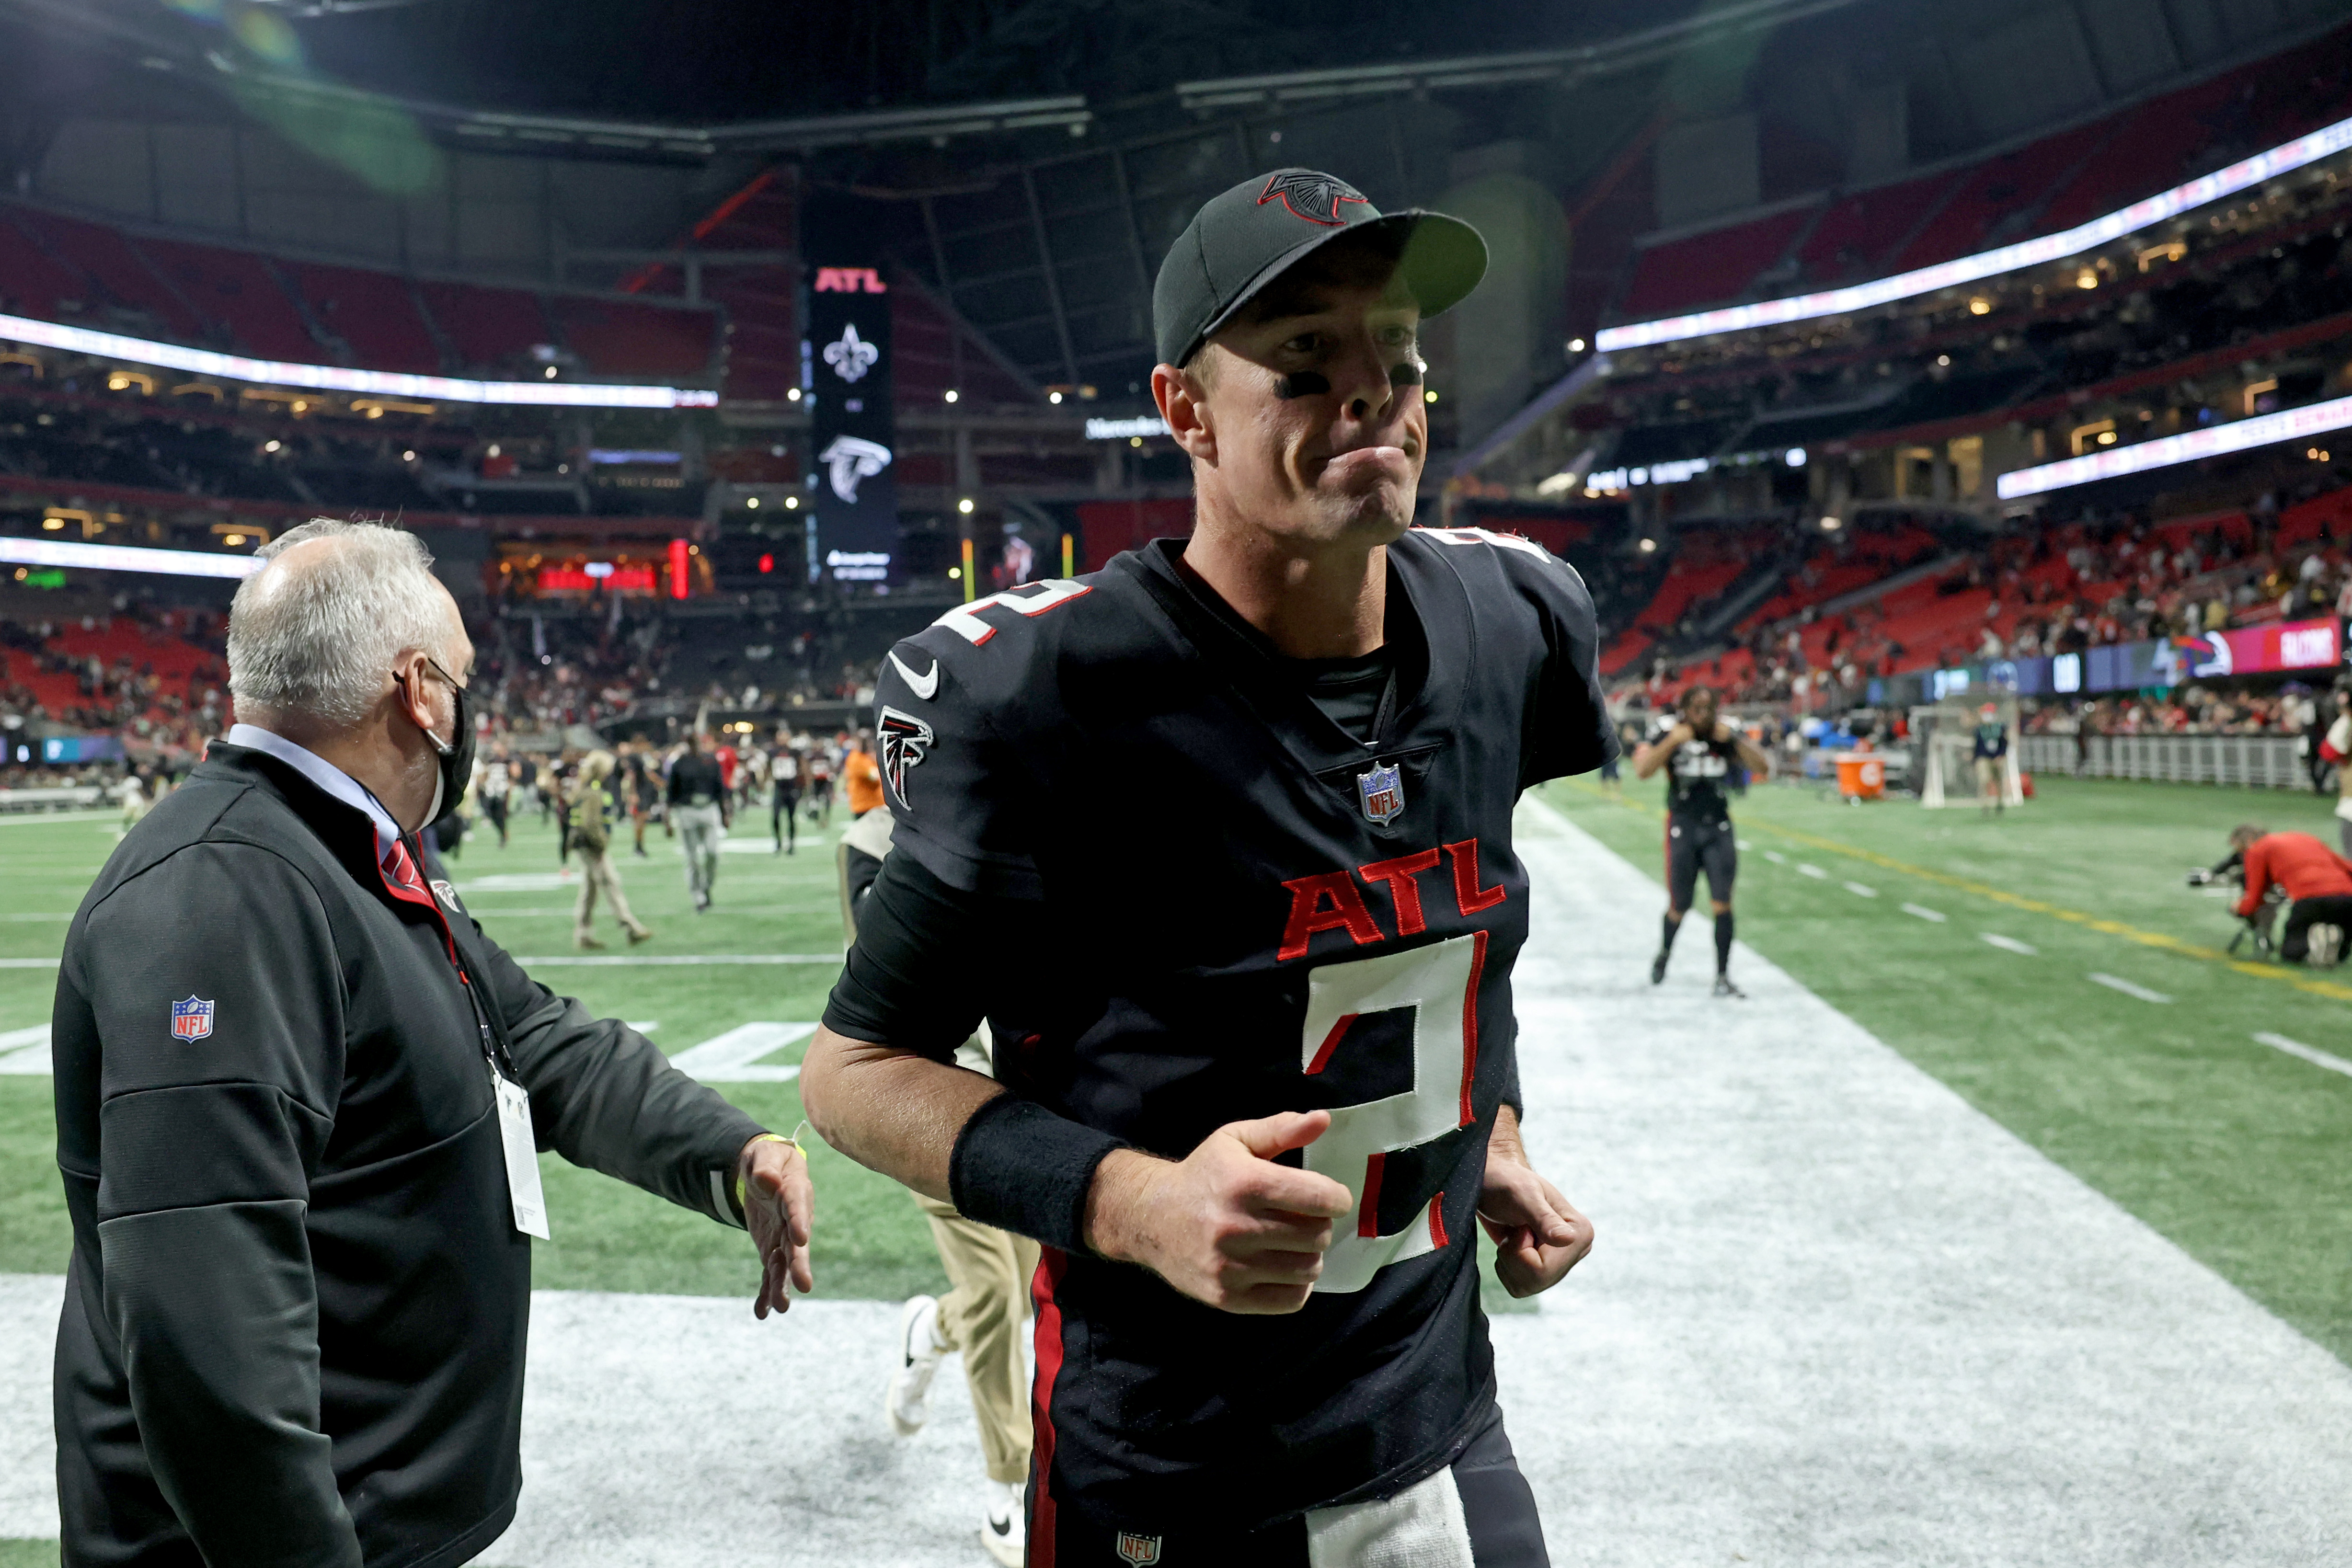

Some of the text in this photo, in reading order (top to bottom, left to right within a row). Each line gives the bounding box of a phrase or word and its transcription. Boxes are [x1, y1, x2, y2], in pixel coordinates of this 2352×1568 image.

[814, 267, 887, 293] ATL
[931, 578, 1093, 646] 2
[1367, 788, 1400, 815] NFL
[1276, 837, 1507, 961] ATL
[176, 1016, 207, 1036] NFL
[1301, 930, 1489, 1293] 2
[1124, 1537, 1152, 1559] NFL
